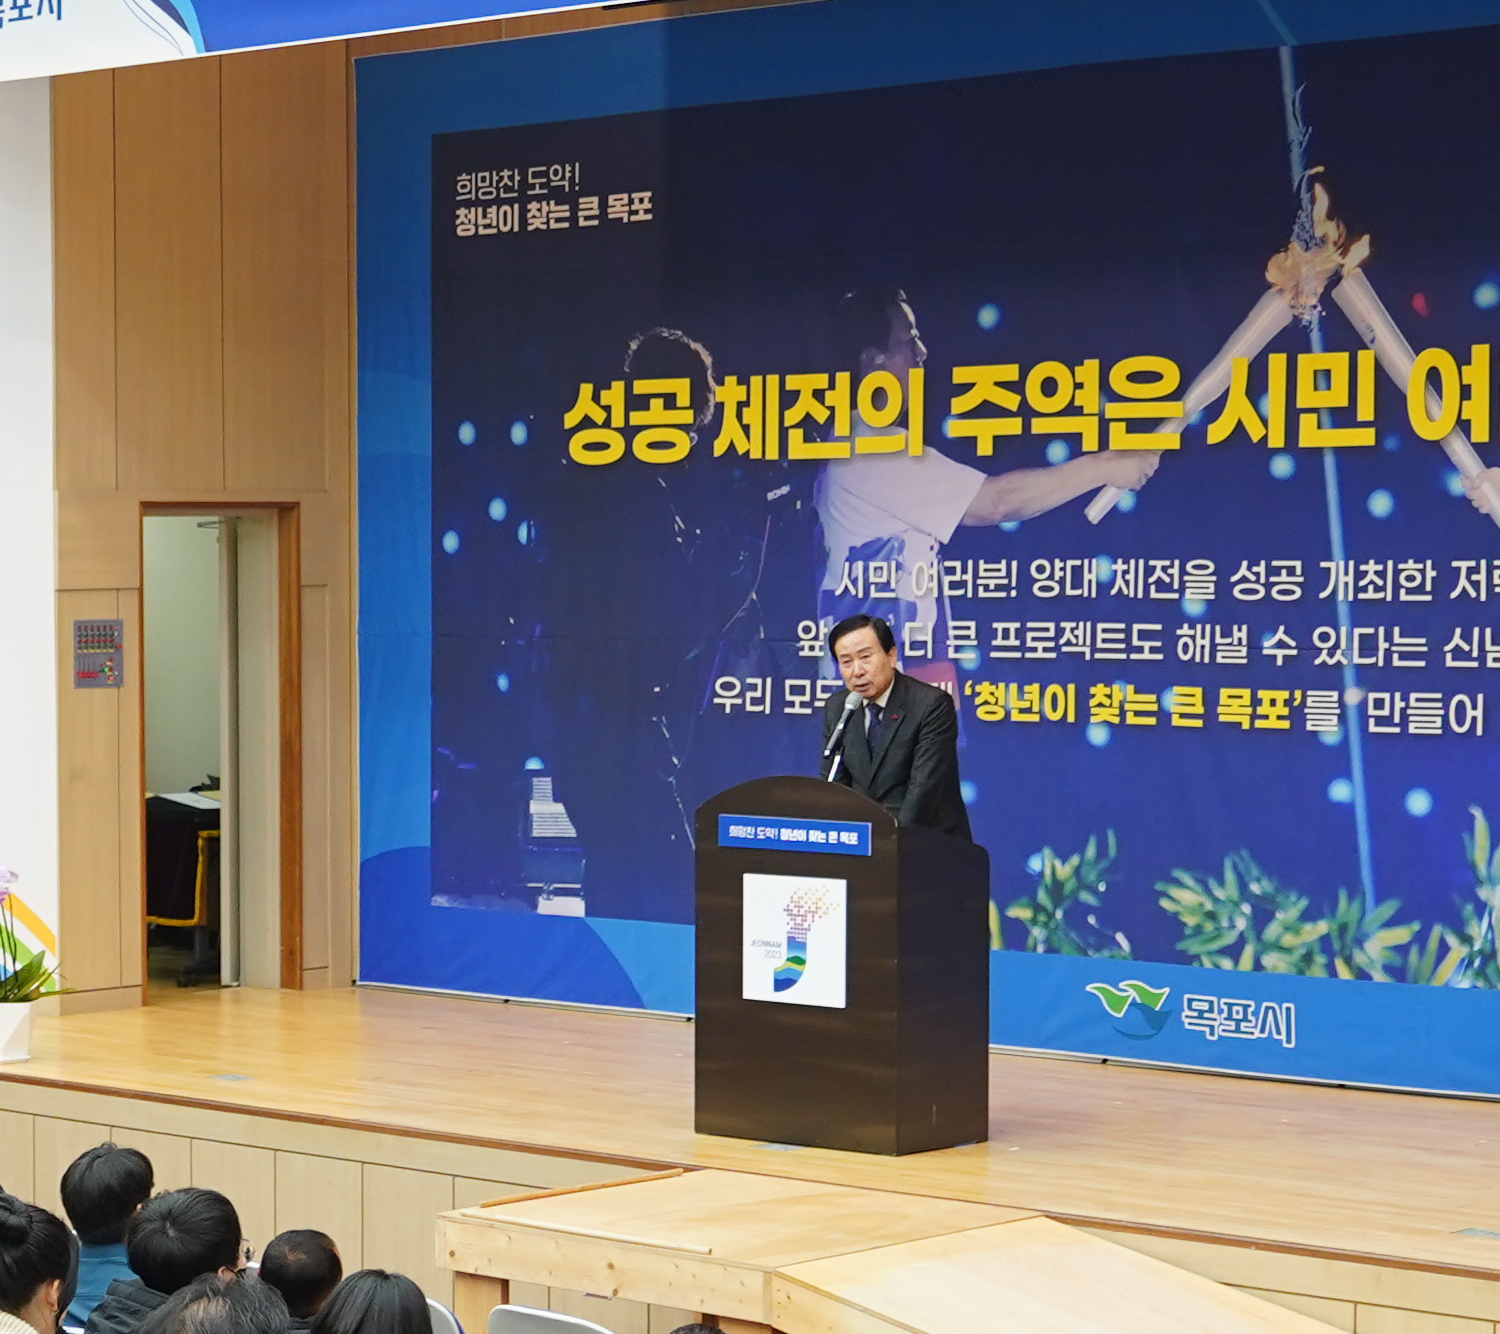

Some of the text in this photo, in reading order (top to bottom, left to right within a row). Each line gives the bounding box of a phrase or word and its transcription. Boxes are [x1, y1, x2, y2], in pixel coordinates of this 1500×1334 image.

[455, 162, 580, 200] 희망찬 도약!
[455, 191, 653, 237] 청년이 찾는 큰 목포
[563, 377, 695, 466] 성공
[713, 367, 925, 460] 체전의
[949, 355, 1186, 456] 주역은
[1207, 350, 1376, 448] 시민
[834, 559, 900, 599] 시민
[909, 558, 1018, 600] 여러분!
[1029, 557, 1098, 599] 양대
[1109, 558, 1217, 601] 체전을
[1229, 560, 1304, 601] 성공
[1319, 559, 1437, 602] 개최한
[904, 621, 934, 659] 더
[946, 621, 978, 660] 큰
[989, 620, 1164, 663] 프로젝트도
[1175, 623, 1250, 666] 해낼
[1262, 626, 1299, 665] 수
[1311, 625, 1429, 669] 있다는
[712, 675, 772, 715] 우리
[1088, 683, 1157, 726] 찾는
[1169, 687, 1205, 727] 큰
[1366, 690, 1484, 737] 만들어
[1181, 993, 1296, 1048] 목포시
